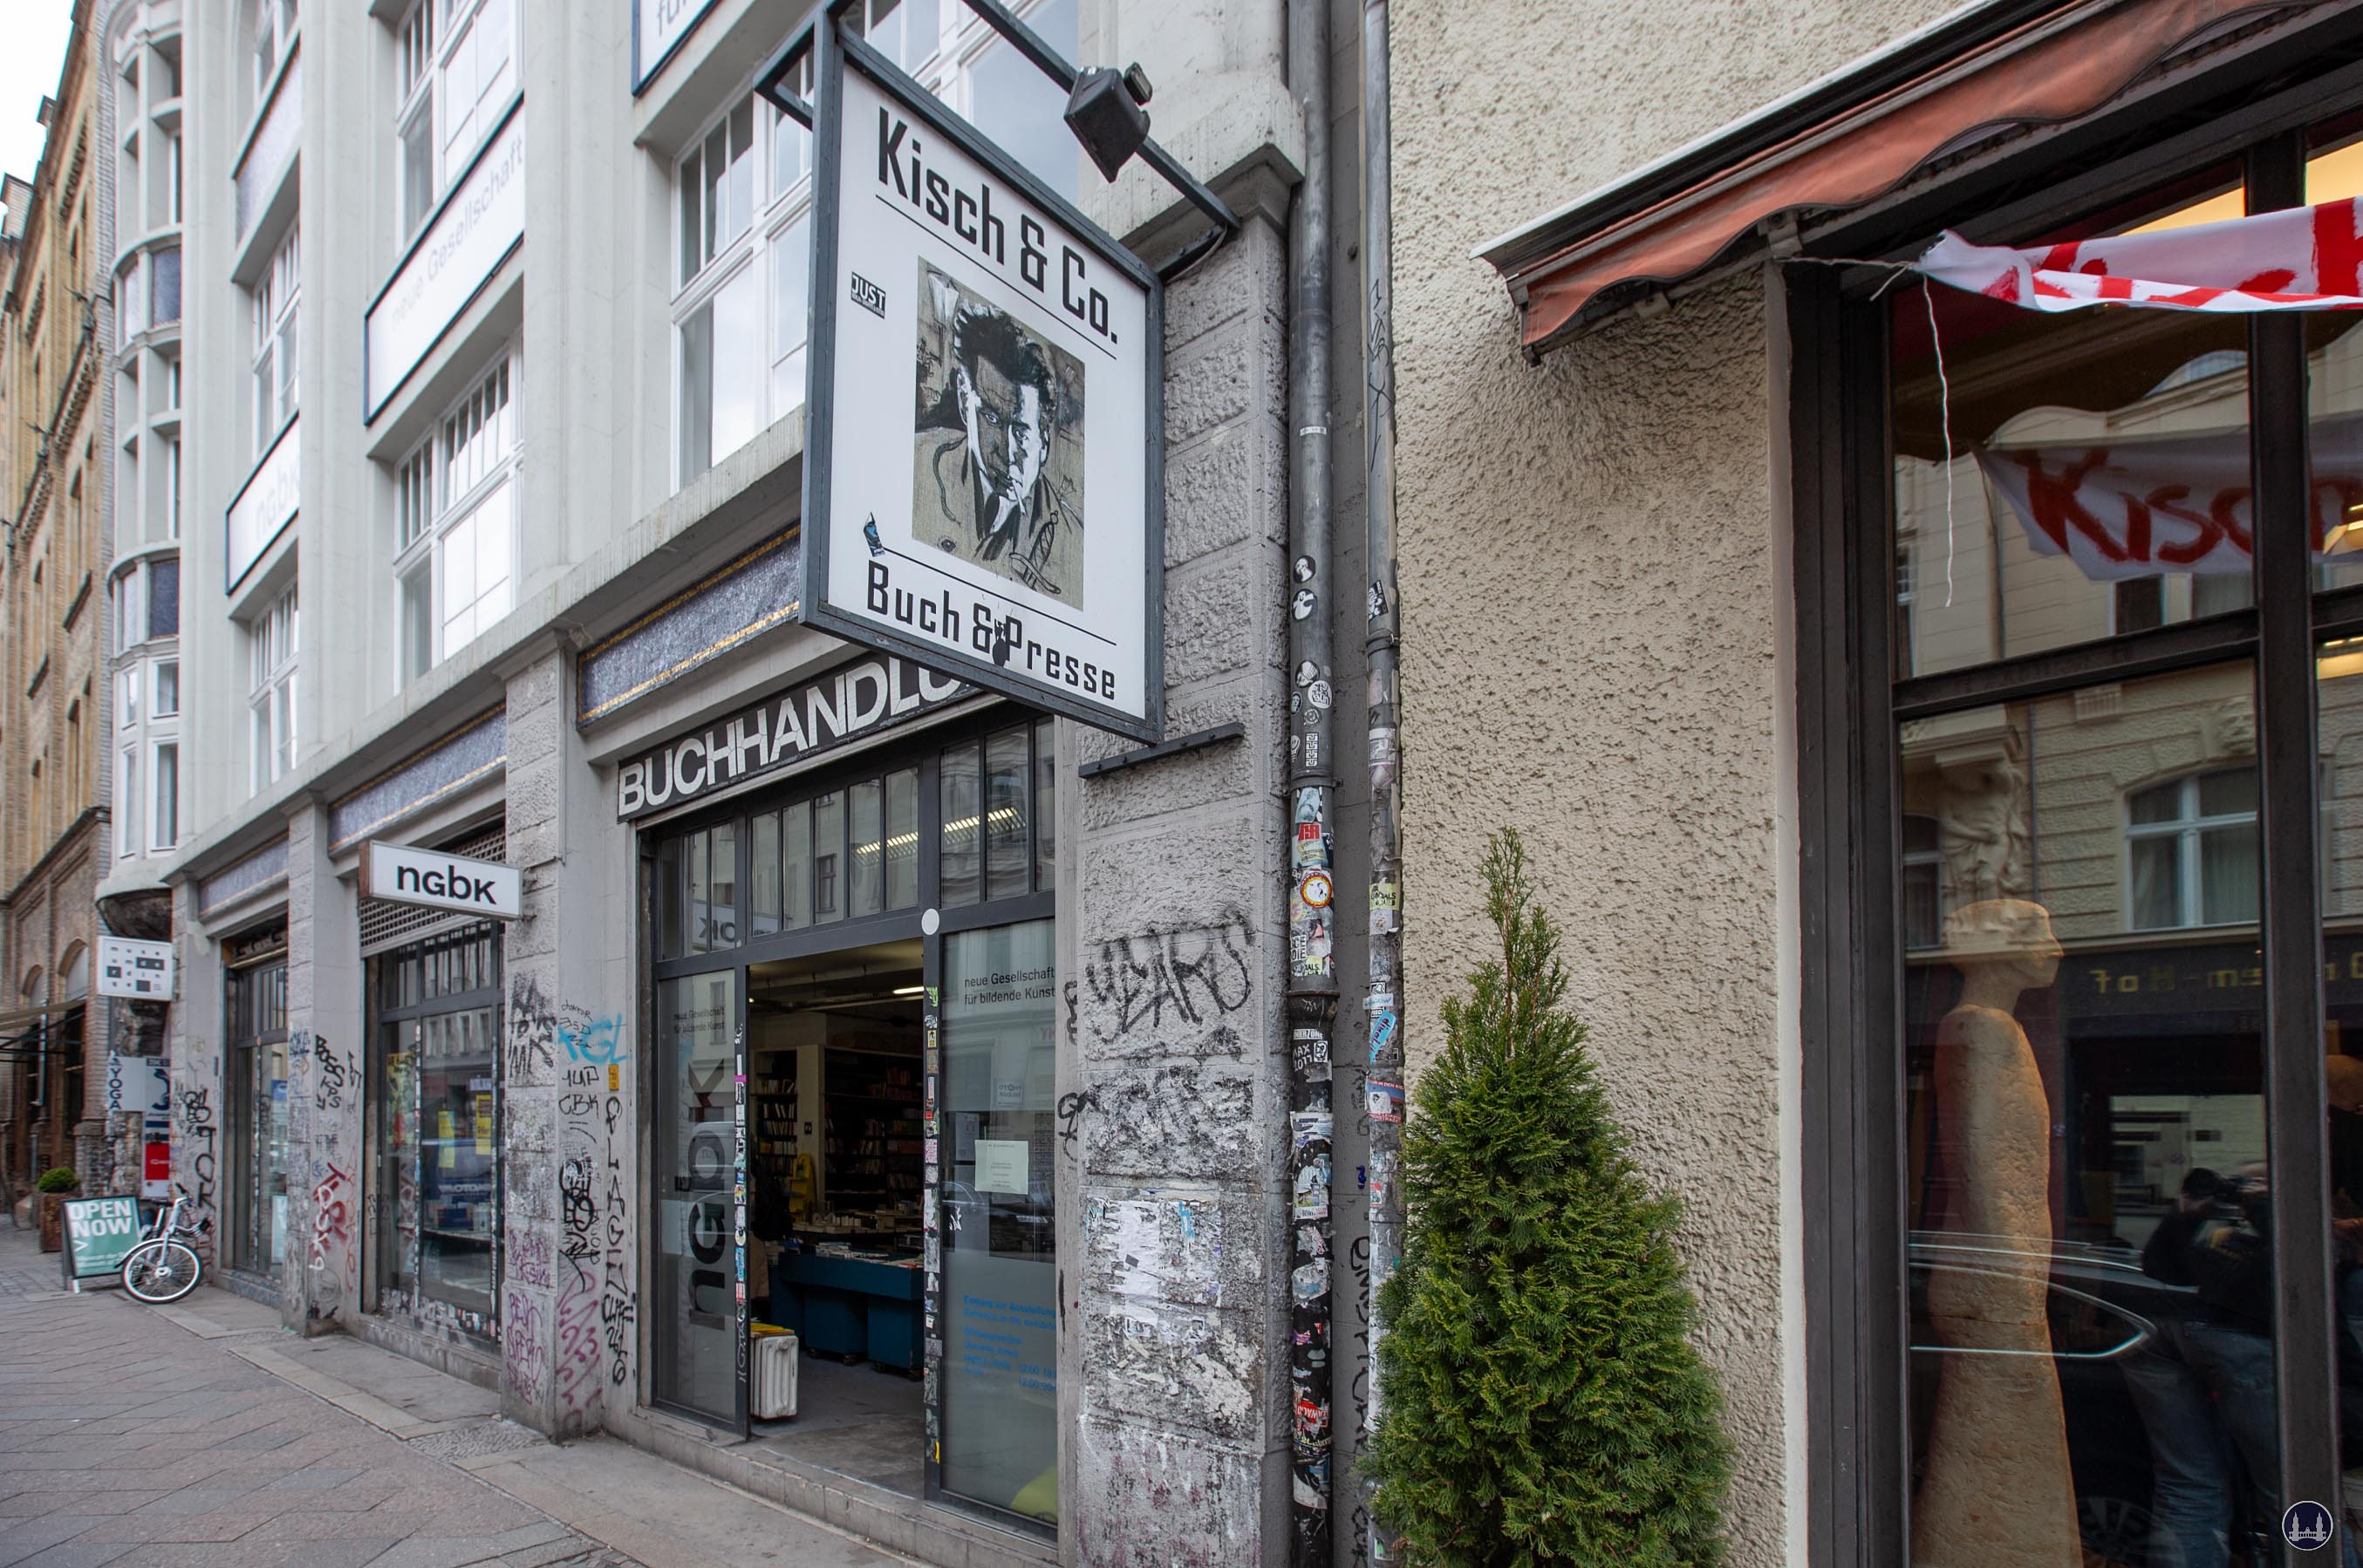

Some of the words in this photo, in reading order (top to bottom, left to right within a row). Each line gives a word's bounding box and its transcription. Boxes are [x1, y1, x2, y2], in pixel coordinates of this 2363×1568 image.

[427, 133, 523, 283] Gesellschaft
[878, 106, 1005, 266] Kisch
[1020, 213, 1047, 294] &
[1062, 244, 1118, 344] Co.
[852, 274, 886, 310] JUST
[866, 559, 960, 643] Buch
[973, 602, 993, 654] &
[1005, 614, 1116, 700] Presse
[964, 976, 988, 988] neue
[991, 966, 1055, 985] Gesellschaft
[964, 992, 977, 1005] für
[980, 990, 1021, 1004] bildende
[1025, 986, 1055, 1000] Kunst
[108, 1067, 123, 1110] YOGA
[68, 1199, 132, 1220] OPEN
[71, 1217, 133, 1238] NOW
